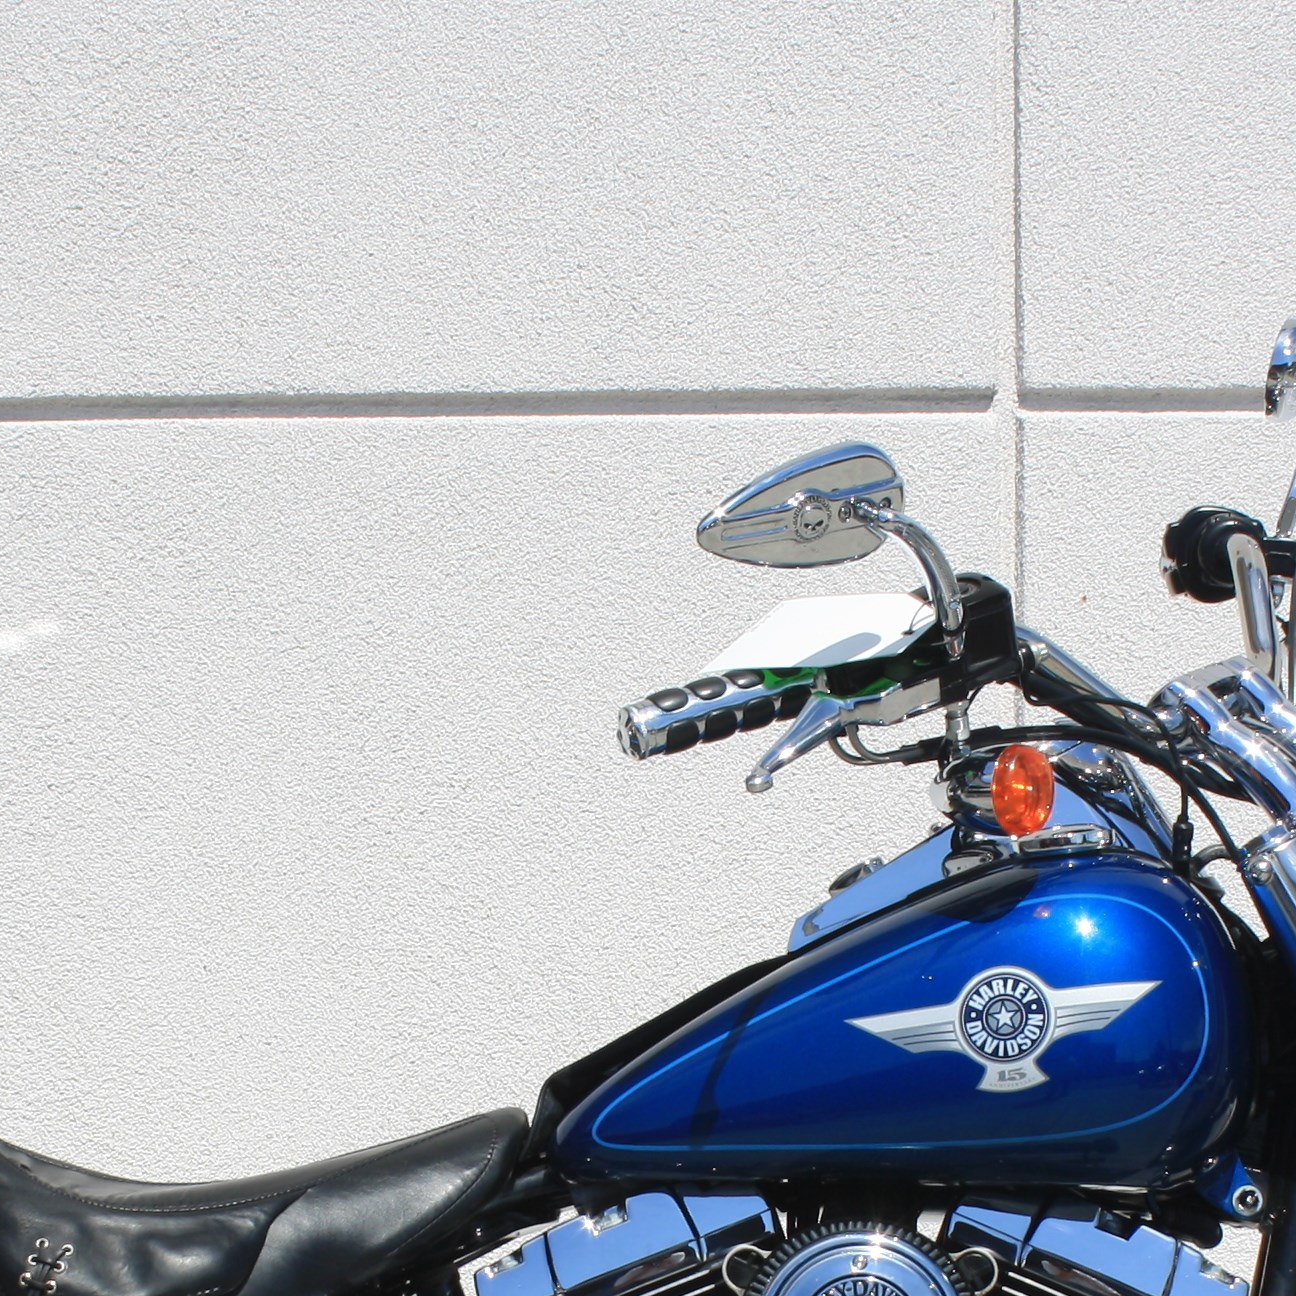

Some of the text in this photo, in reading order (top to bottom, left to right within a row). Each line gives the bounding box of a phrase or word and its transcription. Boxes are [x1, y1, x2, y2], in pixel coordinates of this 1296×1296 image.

[968, 978, 1038, 1011] HARLEY
[965, 1013, 1044, 1057] DAVIDSON
[997, 1067, 1027, 1082] 15
